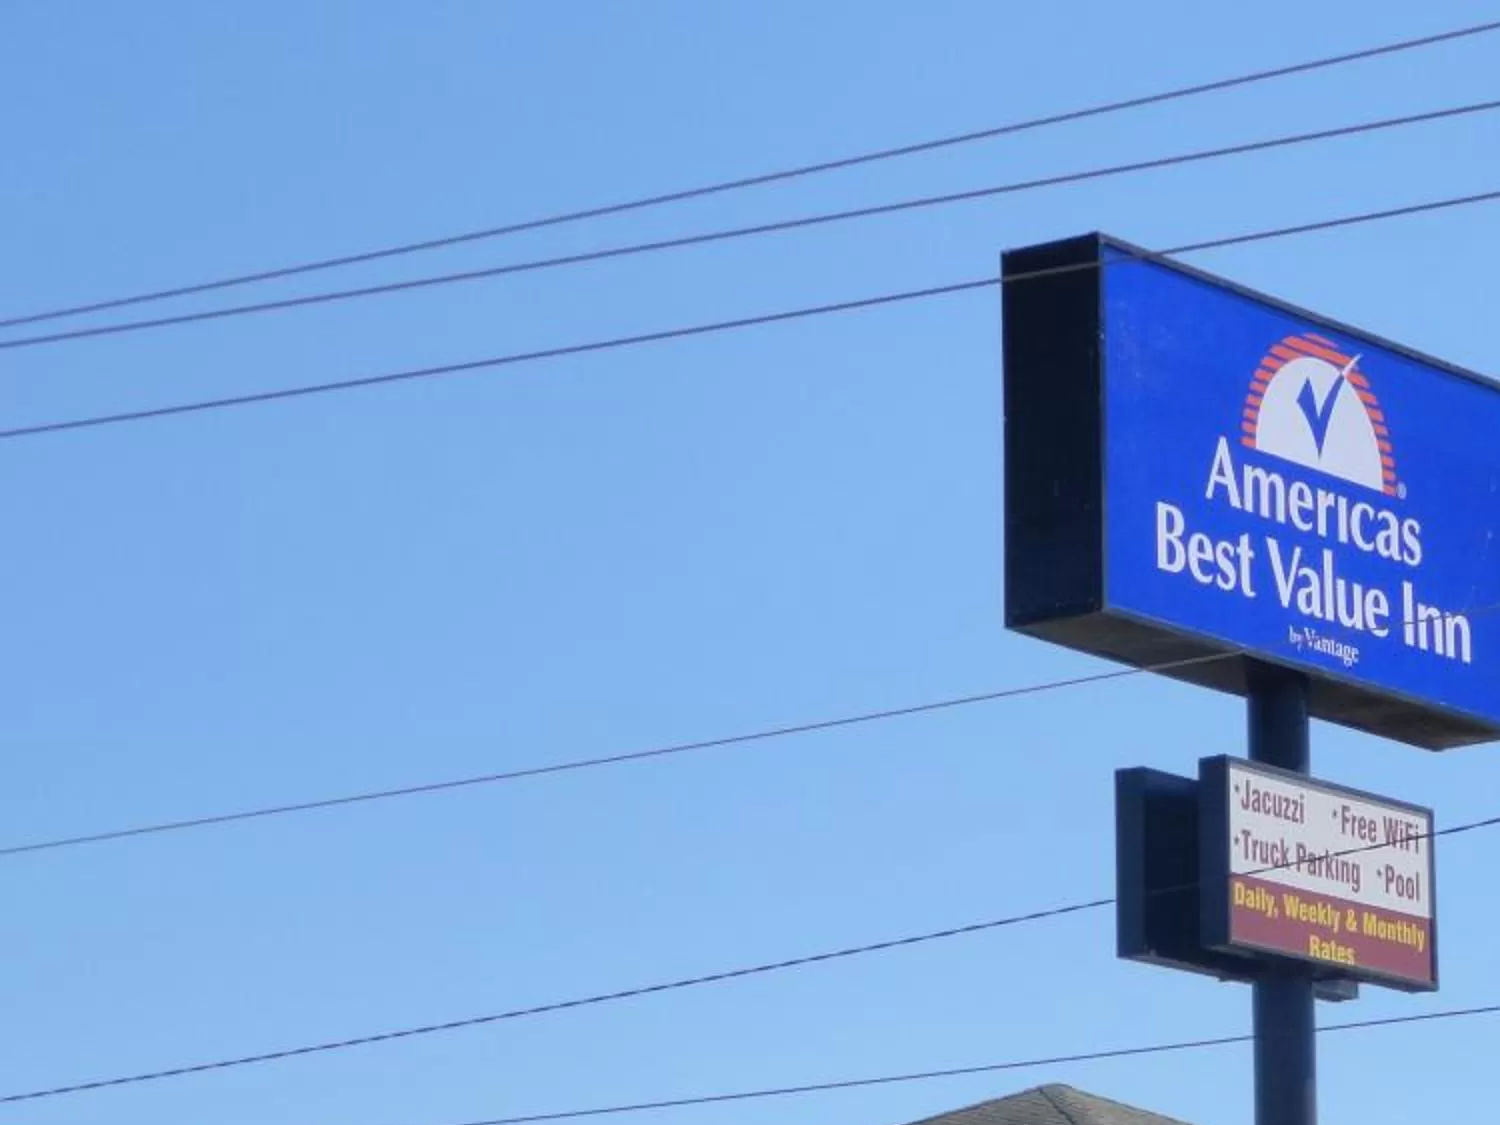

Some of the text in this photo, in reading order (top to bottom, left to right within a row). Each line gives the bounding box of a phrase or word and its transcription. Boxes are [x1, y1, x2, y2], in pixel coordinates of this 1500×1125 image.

[1205, 435, 1423, 566] Americas
[1155, 500, 1473, 665] Best Value Inn
[1241, 779, 1305, 825] Jacuzzi
[1340, 805, 1420, 854] Free WiFi
[1242, 829, 1361, 893] Truck Parking
[1384, 864, 1421, 902] Pool
[1233, 880, 1425, 952] Daily, Weekly & Monthly
[1309, 935, 1356, 966] Rates
